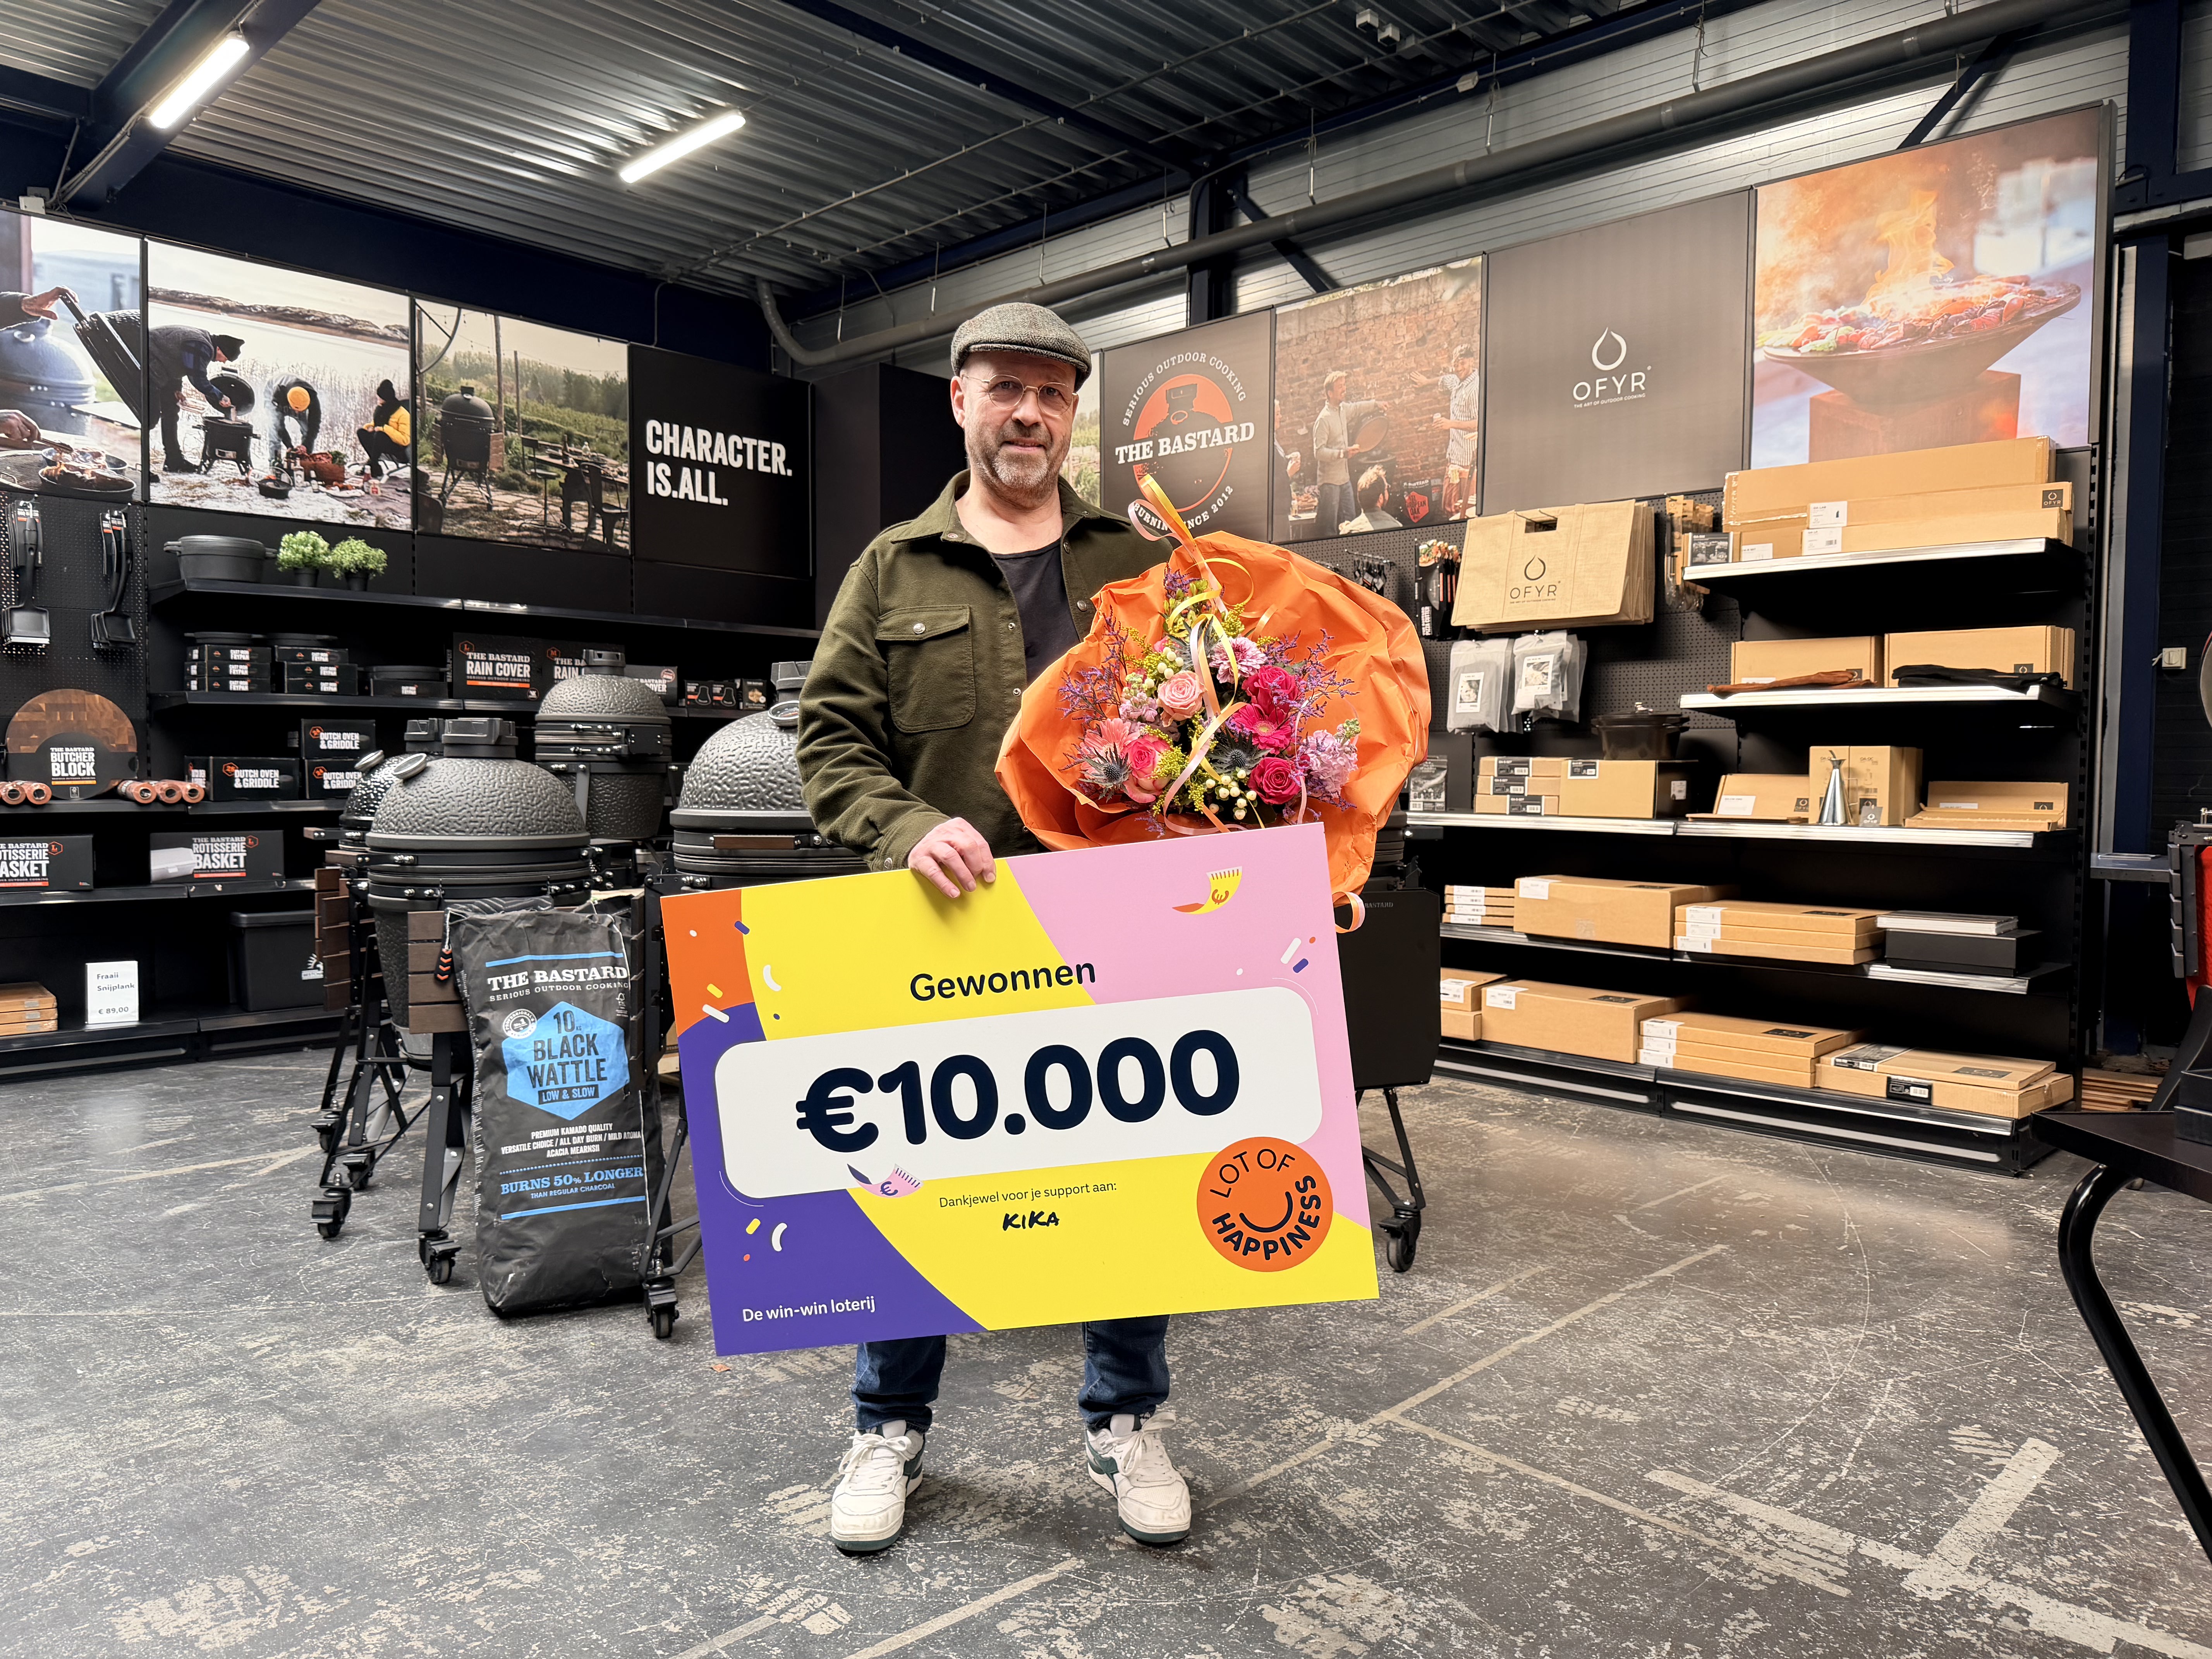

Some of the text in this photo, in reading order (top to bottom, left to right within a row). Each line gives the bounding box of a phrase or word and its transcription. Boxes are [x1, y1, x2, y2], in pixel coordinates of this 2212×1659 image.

[1123, 352, 1246, 426] SERIOUS OUTDOOR COOKING
[1573, 372, 1646, 401] OFYR
[646, 419, 793, 477] CHARACTER.
[1115, 422, 1255, 464] THE BASTARD
[647, 461, 728, 506] IS.ALL.
[1134, 486, 1233, 531] BURNIN NCE 2012
[1510, 584, 1557, 599] OFYR
[467, 652, 531, 663] THE BASTARD
[466, 660, 493, 676] RAIN
[496, 662, 531, 678] COVER
[554, 665, 579, 679] RAIN
[320, 732, 359, 740] DUTCH OVEN
[320, 740, 360, 749] & GRIDDLE
[50, 752, 95, 763] BUTCHER
[51, 762, 96, 776] BLOCK
[234, 769, 280, 778] DUTCH OVEN
[323, 771, 362, 780] DUTCH OVEN
[234, 778, 280, 788] & GRIDDLE
[323, 780, 331, 789] &
[0, 849, 49, 860] TISSERIE
[192, 842, 247, 854] ROTISSERIE
[0, 860, 50, 878] ASKET
[194, 853, 247, 869] BASKET
[97, 983, 135, 992] Snijplank
[487, 966, 628, 991] THE BASTARD
[910, 962, 1096, 1001] Gewonnen
[489, 982, 629, 1002] SERIOUS OUTDOOR COOKING
[553, 1010, 575, 1034] 10
[534, 1033, 599, 1061] BLACK
[527, 1058, 608, 1089] WATTLE
[542, 1087, 595, 1102] LOW & SLOW
[796, 1029, 1240, 1154] €10.000
[531, 1123, 613, 1140] PREMIUM KAMADO QUALITY
[501, 1142, 531, 1154] VERSATILE
[532, 1139, 554, 1150] CHOICE
[559, 1137, 571, 1146] ALL
[572, 1135, 585, 1144] DAY
[586, 1134, 603, 1143] BURN
[608, 1132, 622, 1141] MILD
[623, 1131, 641, 1139] AROMA
[546, 1144, 600, 1158] ACACIA MEARNSII
[500, 1167, 644, 1195] BURNS 50% LONGER
[1210, 1149, 1295, 1198] LOT OF
[550, 1187, 579, 1197] REGULAR
[580, 1183, 616, 1193] CHARCOAL
[939, 1182, 1117, 1208] Dankjewel voor je support aan:
[1212, 1175, 1321, 1261] HAPPINESS
[742, 1296, 876, 1322] De win-win loterij
